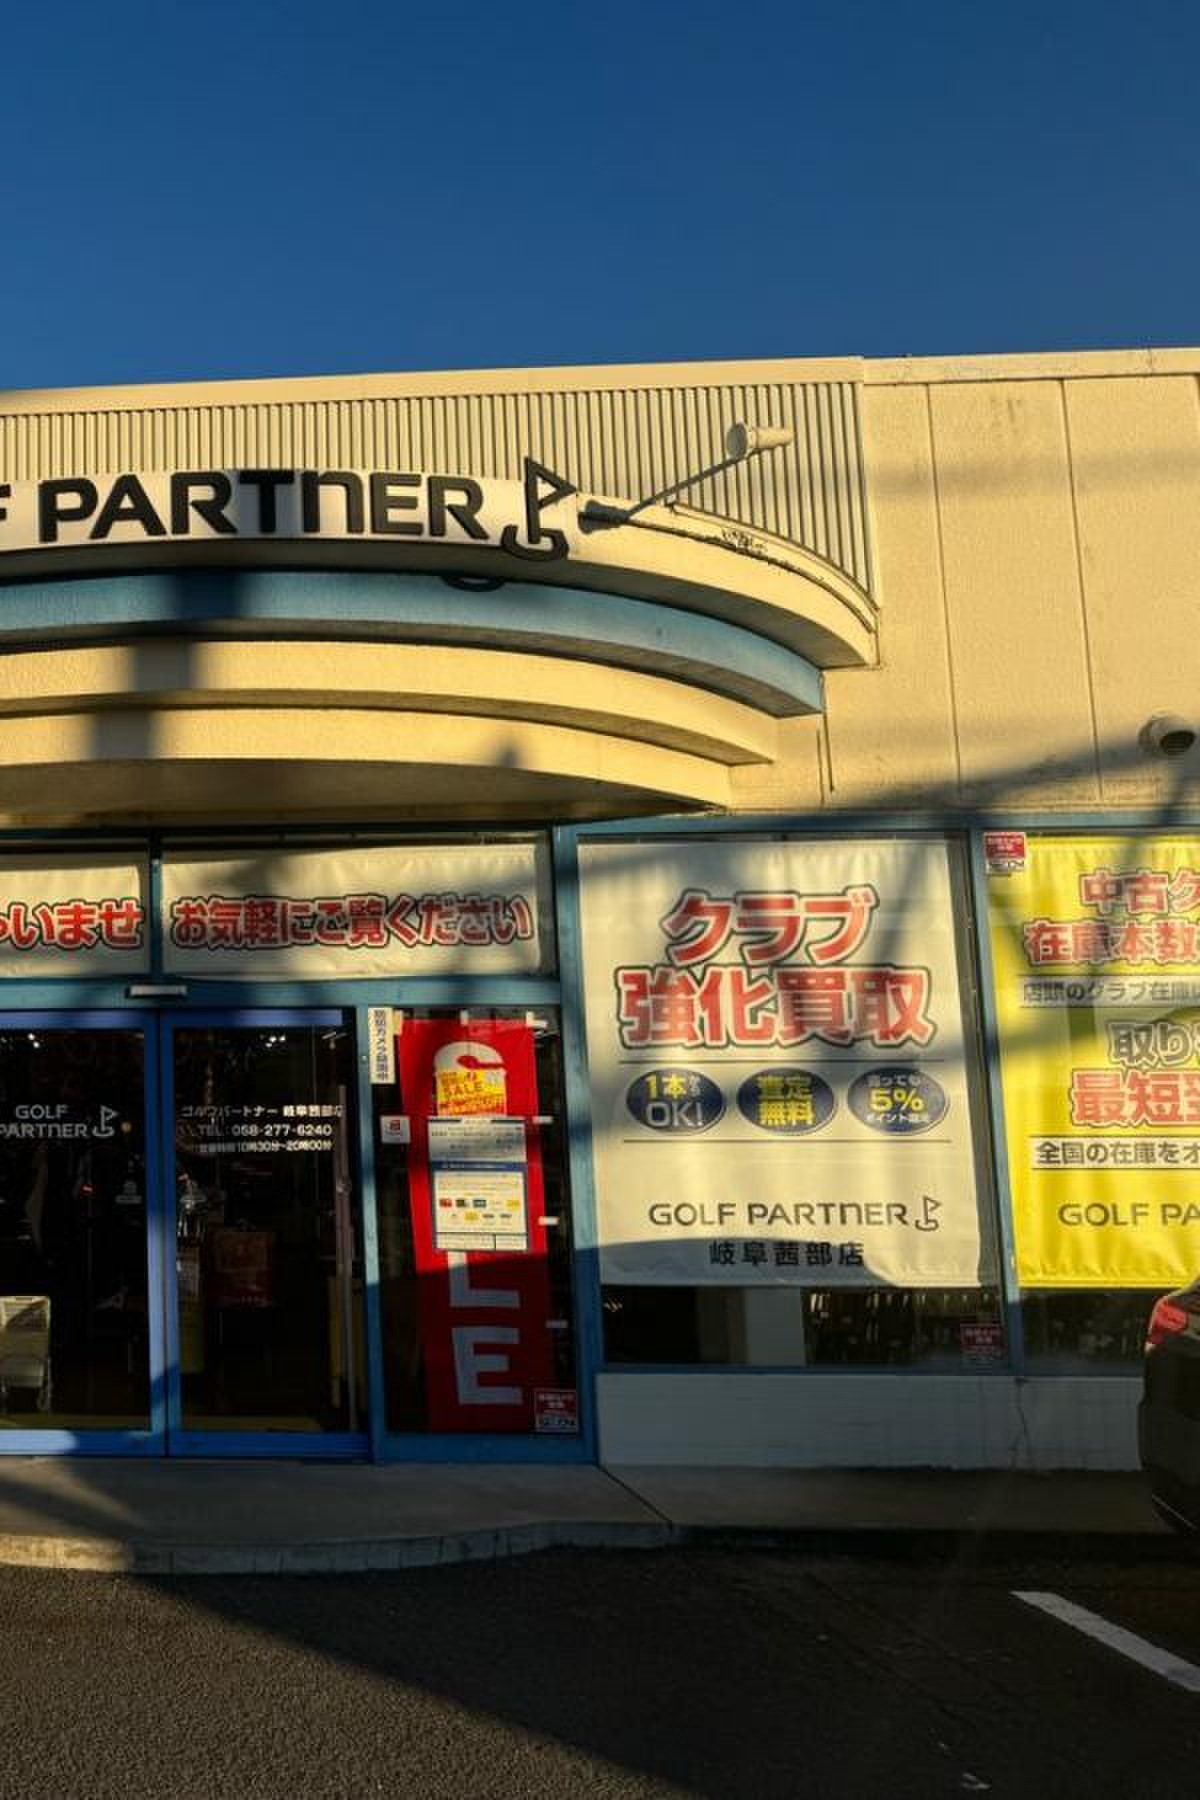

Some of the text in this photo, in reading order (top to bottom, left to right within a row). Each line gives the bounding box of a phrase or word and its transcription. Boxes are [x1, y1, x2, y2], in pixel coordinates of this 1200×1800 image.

[37, 467, 490, 542] PARTNER
[170, 893, 536, 950] お気軽にご覧ください
[660, 883, 880, 967] クラブ
[615, 964, 936, 1050] 強化買取
[1107, 1020, 1200, 1067] 取り
[15, 1104, 68, 1120] GOLF
[759, 1101, 815, 1127] 無料
[870, 1088, 925, 1113] 5%
[645, 1102, 705, 1128] OK!
[648, 1201, 910, 1227] GOLF PARTNER
[1057, 1202, 1150, 1227] GOLF
[708, 1240, 865, 1268] 岐阜茜部店
